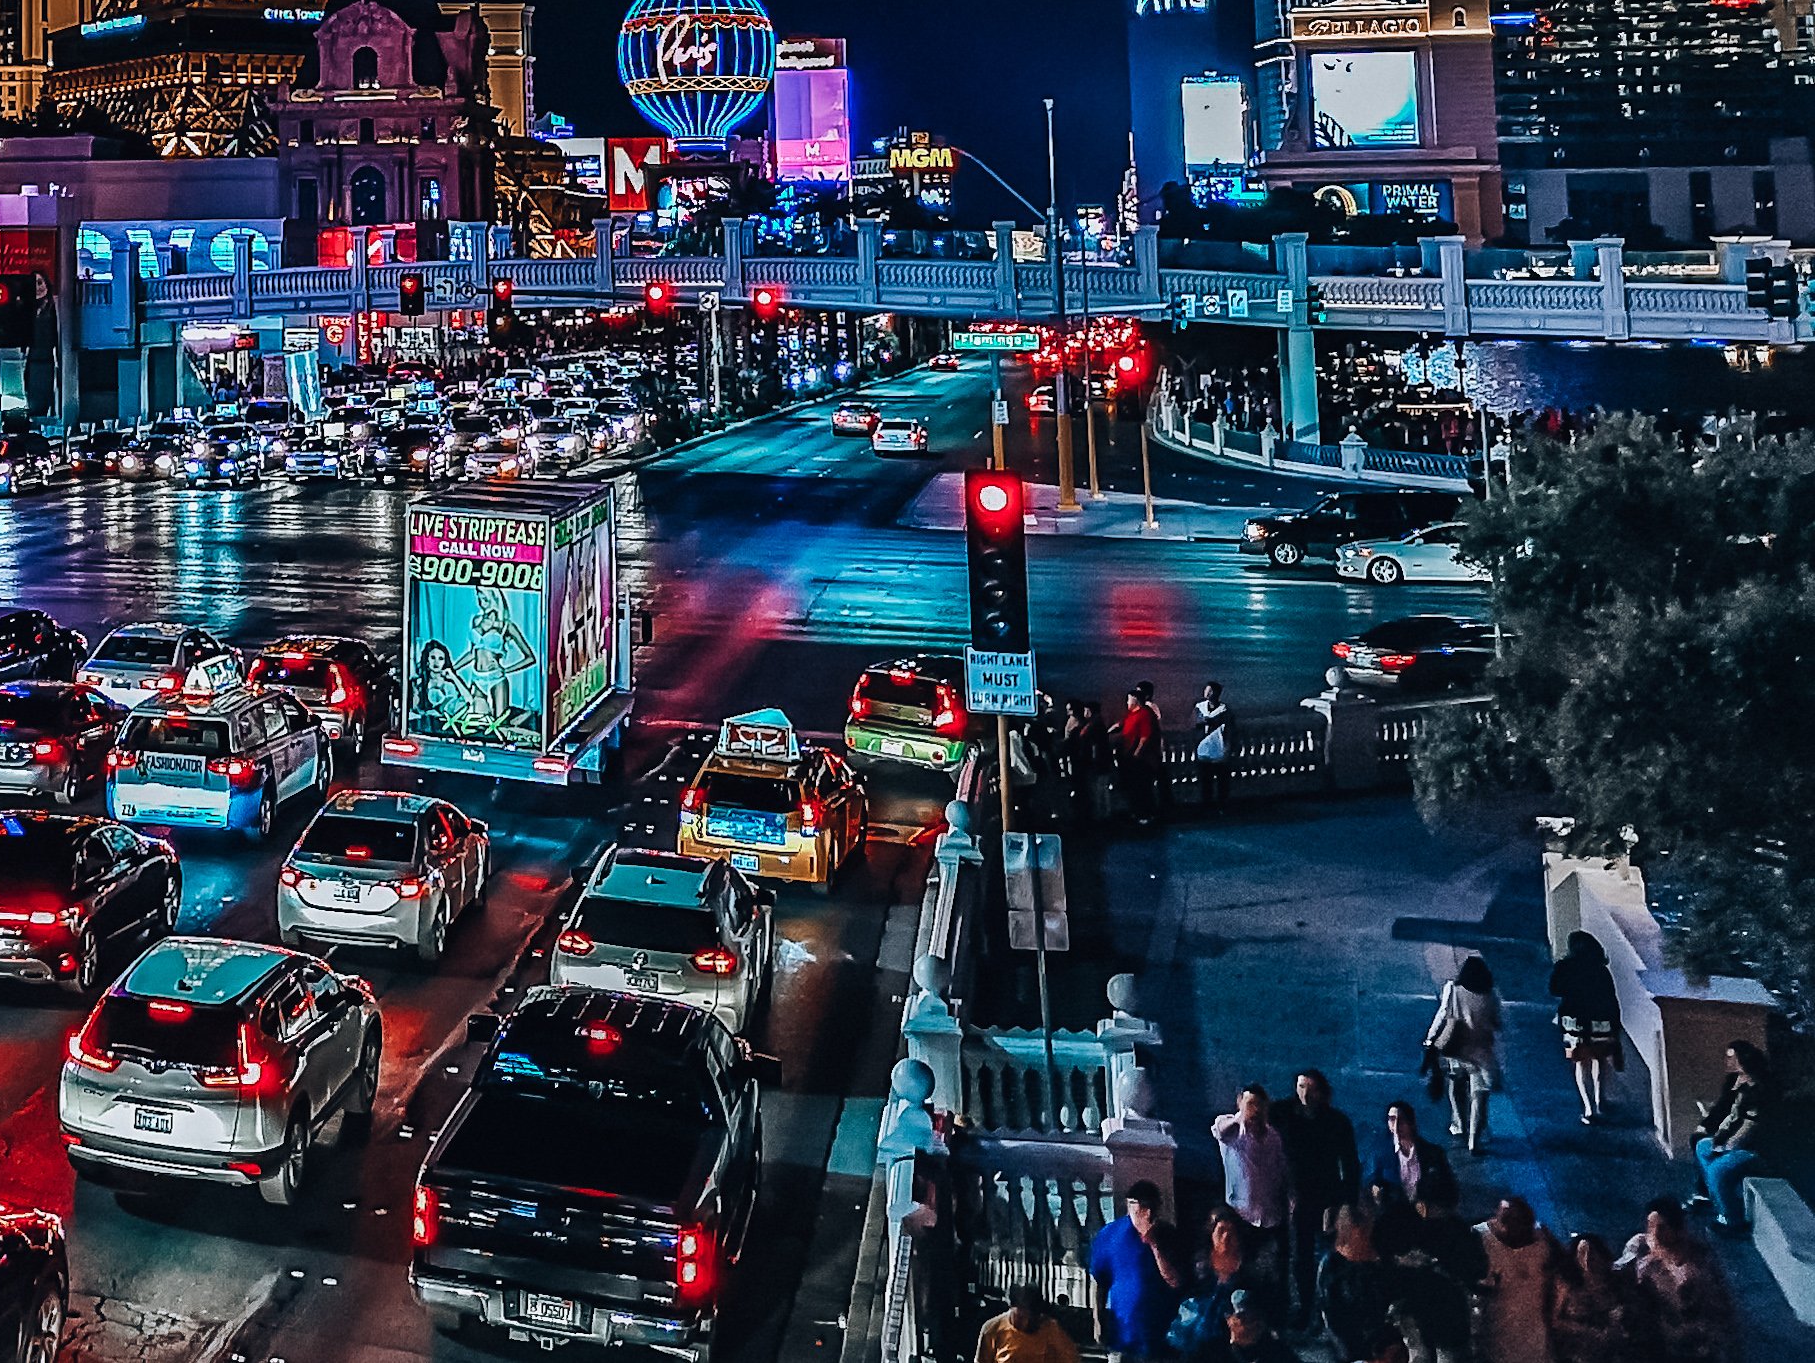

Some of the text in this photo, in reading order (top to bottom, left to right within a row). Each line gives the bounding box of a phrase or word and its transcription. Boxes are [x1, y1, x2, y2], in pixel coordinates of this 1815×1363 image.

[1308, 17, 1422, 37] BELLAGIO
[656, 14, 717, 85] Paris
[889, 147, 954, 169] MGM
[1383, 184, 1440, 197] PRIMAL
[1386, 195, 1438, 209] WATER
[409, 513, 445, 538] LIVE
[448, 516, 545, 547] STRIPTEASE
[438, 540, 517, 559] CALL NOW
[422, 556, 543, 590] 900-9008
[970, 653, 1030, 667] RIGHT LANE
[982, 672, 1019, 687] MUST
[971, 691, 1032, 706] TURN RIGHT
